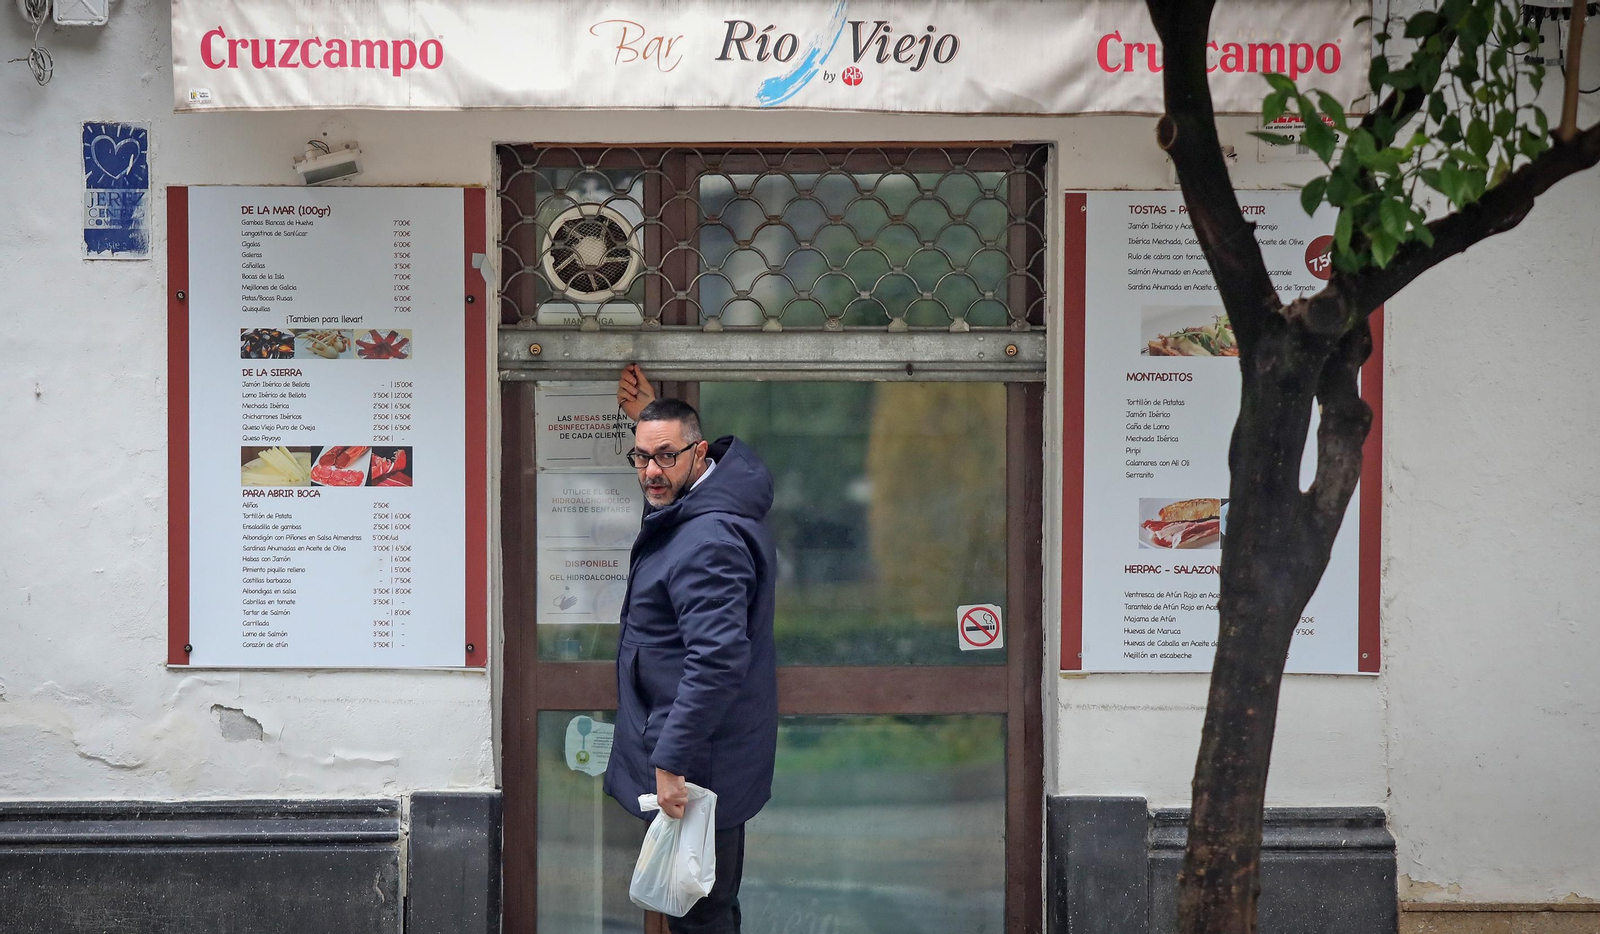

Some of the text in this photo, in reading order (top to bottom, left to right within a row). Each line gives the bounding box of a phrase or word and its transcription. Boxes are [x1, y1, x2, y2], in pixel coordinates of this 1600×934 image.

[589, 19, 684, 73] Bar
[715, 19, 961, 72] Río Viejo
[200, 26, 444, 77] Cruzcampo
[1097, 30, 1342, 81] Crucampo
[823, 70, 836, 83] by
[87, 191, 145, 208] JEREZ
[241, 205, 331, 218] DE LA MAR (100gr)
[1128, 205, 1167, 214] TOSTAS
[1174, 224, 1179, 232] y
[241, 230, 273, 238] Langostinos
[241, 241, 260, 249] Cigalas
[1152, 237, 1182, 246] Mechada,
[242, 284, 269, 292] Mejillones
[242, 294, 275, 303] Patas/Bocas
[242, 305, 270, 314] Quisquillas
[286, 315, 363, 325] ¡Tambien para llevar!
[256, 368, 268, 376] LA
[270, 368, 302, 376] SIERRA
[1126, 372, 1192, 382] MONTADITOS
[242, 424, 260, 432] Queso
[261, 424, 275, 432] Viejo
[299, 424, 315, 432] Oveja
[242, 434, 281, 443] Queso Payoyo
[1126, 447, 1141, 455] Piripi
[242, 489, 320, 498] PARA ABRIR BOCA
[267, 566, 286, 574] piquillo
[1125, 564, 1161, 574] HERPAC
[1124, 615, 1149, 624] Mojama
[1124, 652, 1148, 660] Mejillón
